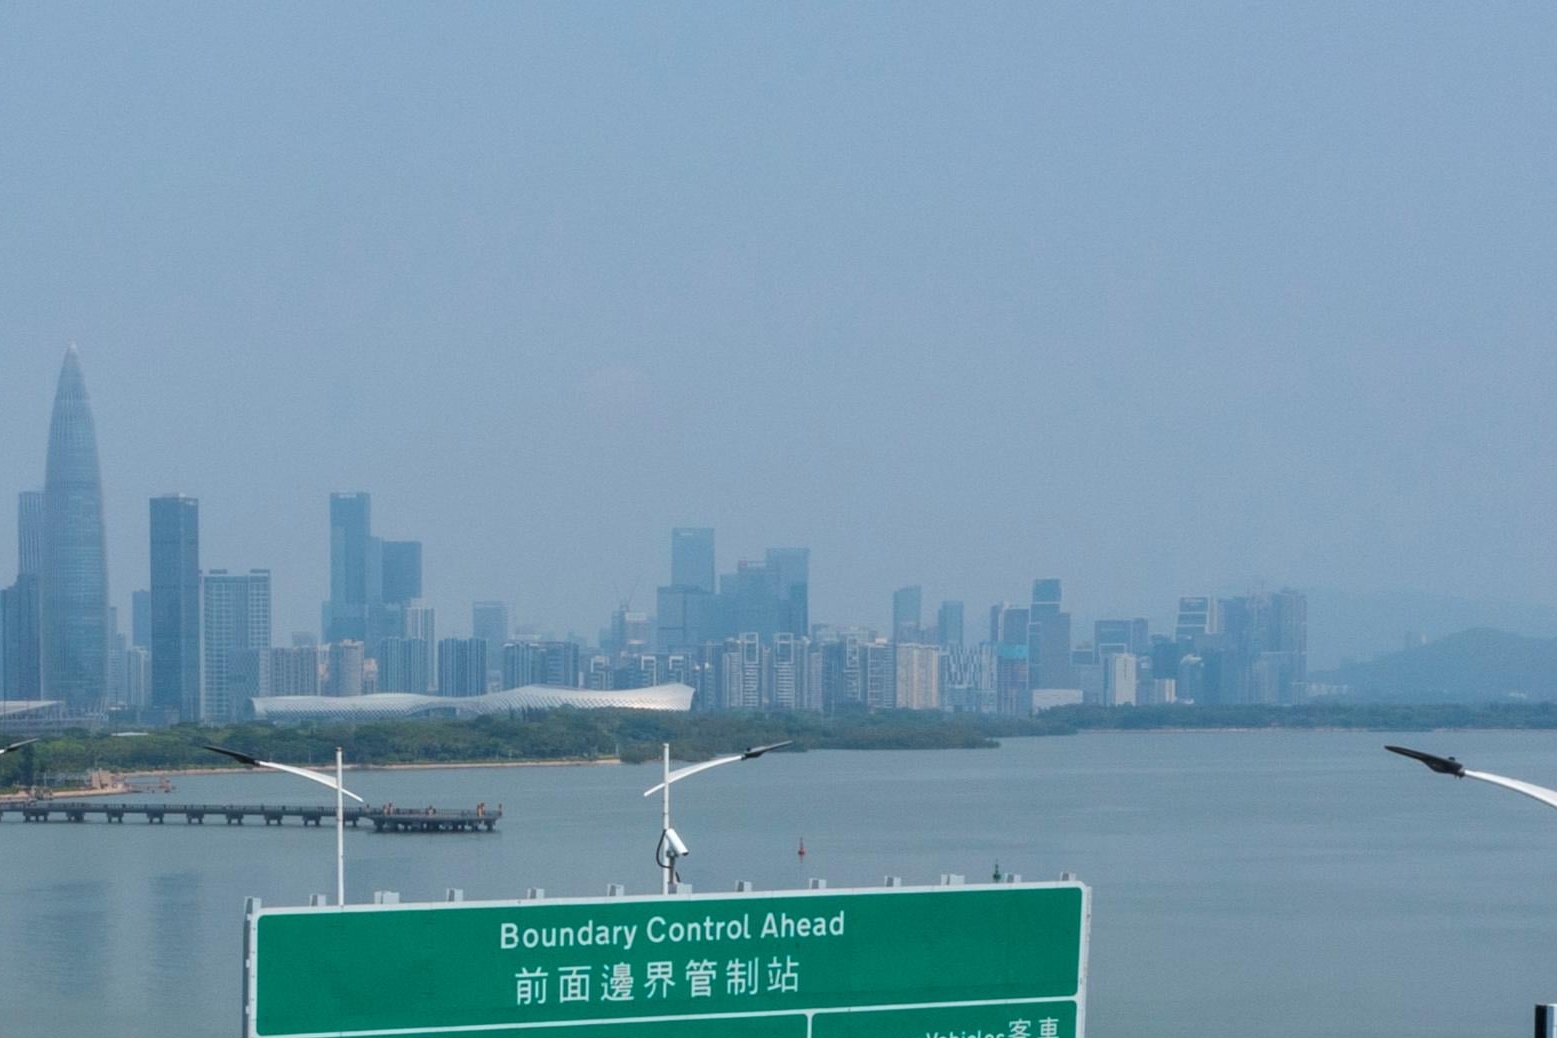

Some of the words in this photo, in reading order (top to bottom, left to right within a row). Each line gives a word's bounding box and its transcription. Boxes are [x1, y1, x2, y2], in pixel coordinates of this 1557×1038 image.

[500, 920, 637, 950] Boundary
[646, 914, 751, 943] Control
[761, 911, 844, 938] Ahead
[514, 955, 800, 1005] 前面邊界管制站
